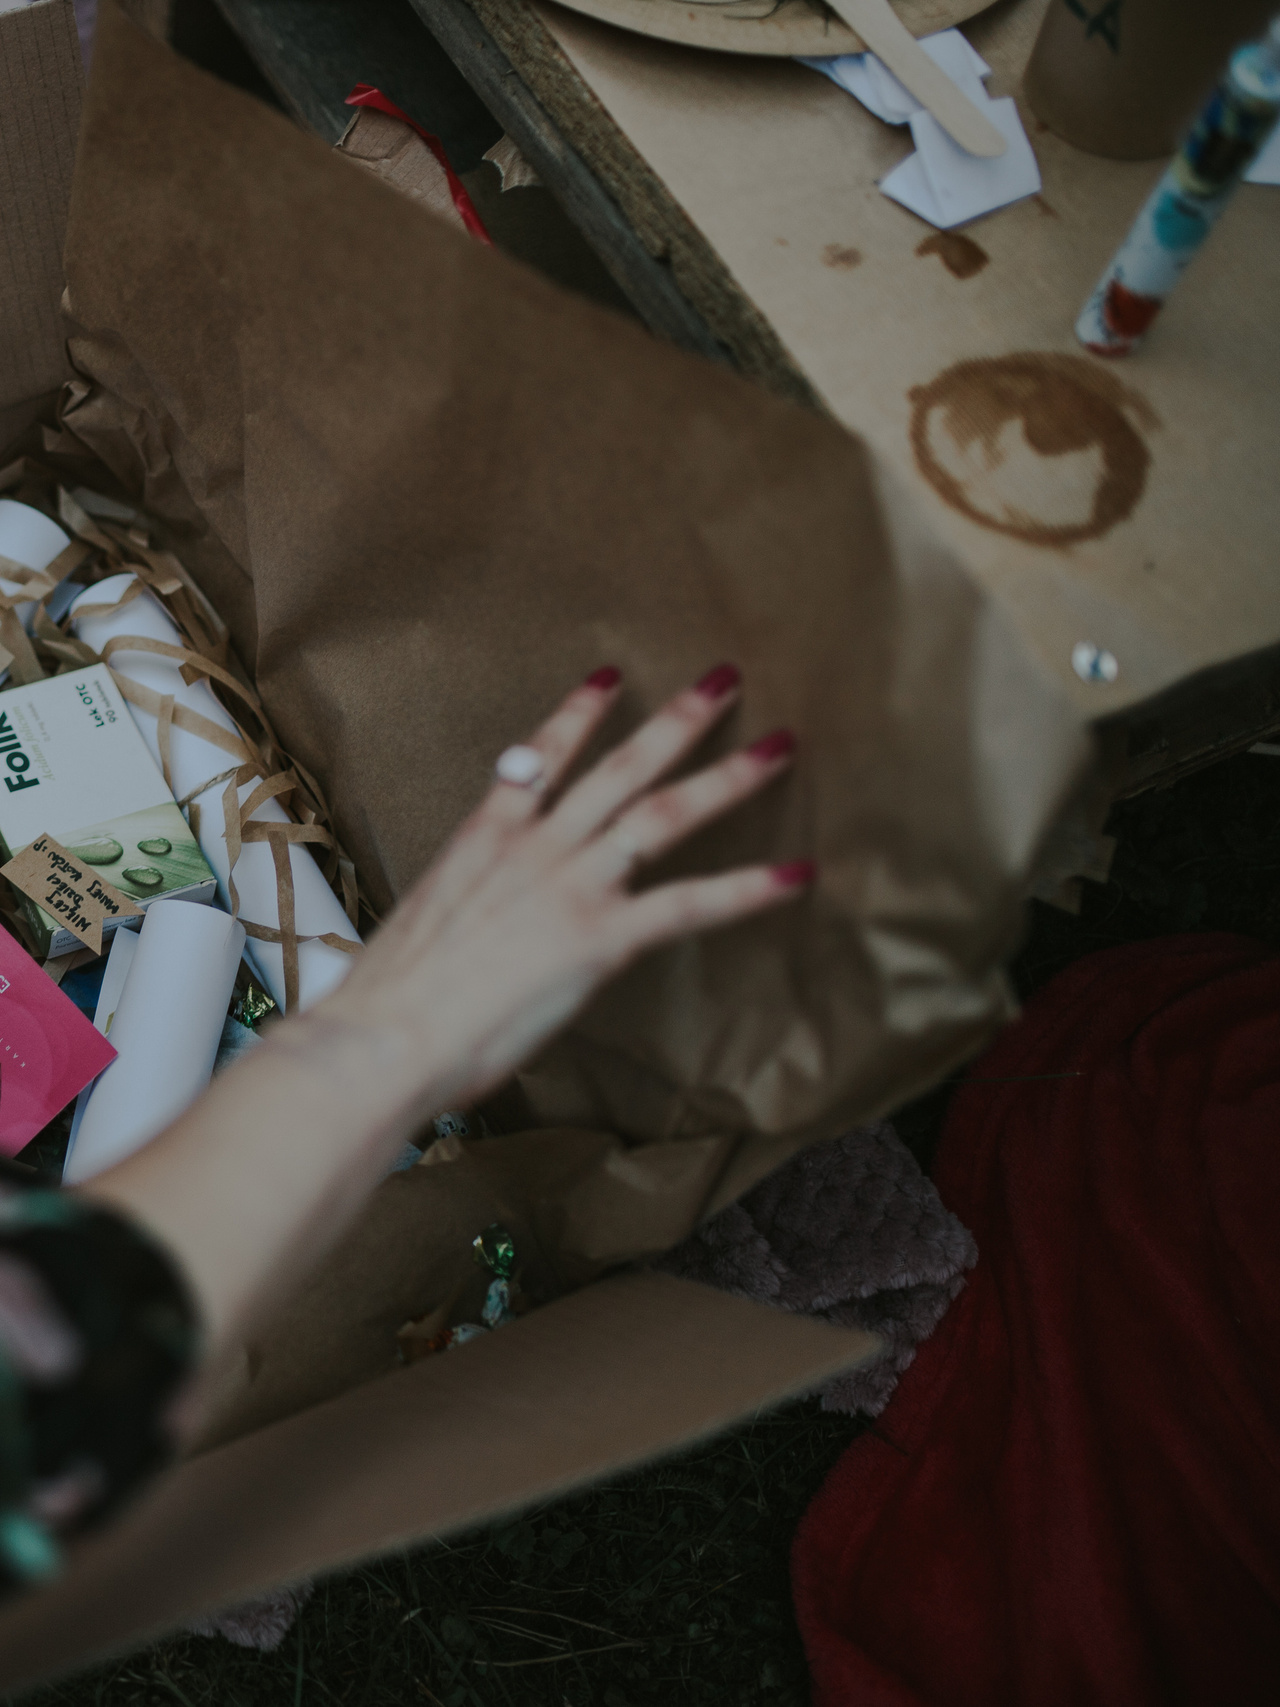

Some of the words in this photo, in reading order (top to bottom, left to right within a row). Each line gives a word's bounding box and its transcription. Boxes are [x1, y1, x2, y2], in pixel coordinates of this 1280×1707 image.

[76, 683, 93, 705] OTC
[89, 708, 105, 727] Lek
[106, 710, 118, 723] 90
[46, 873, 84, 908] DZIECI
[86, 880, 120, 914] MNIEJ
[45, 890, 91, 932] WIĘCEJ
